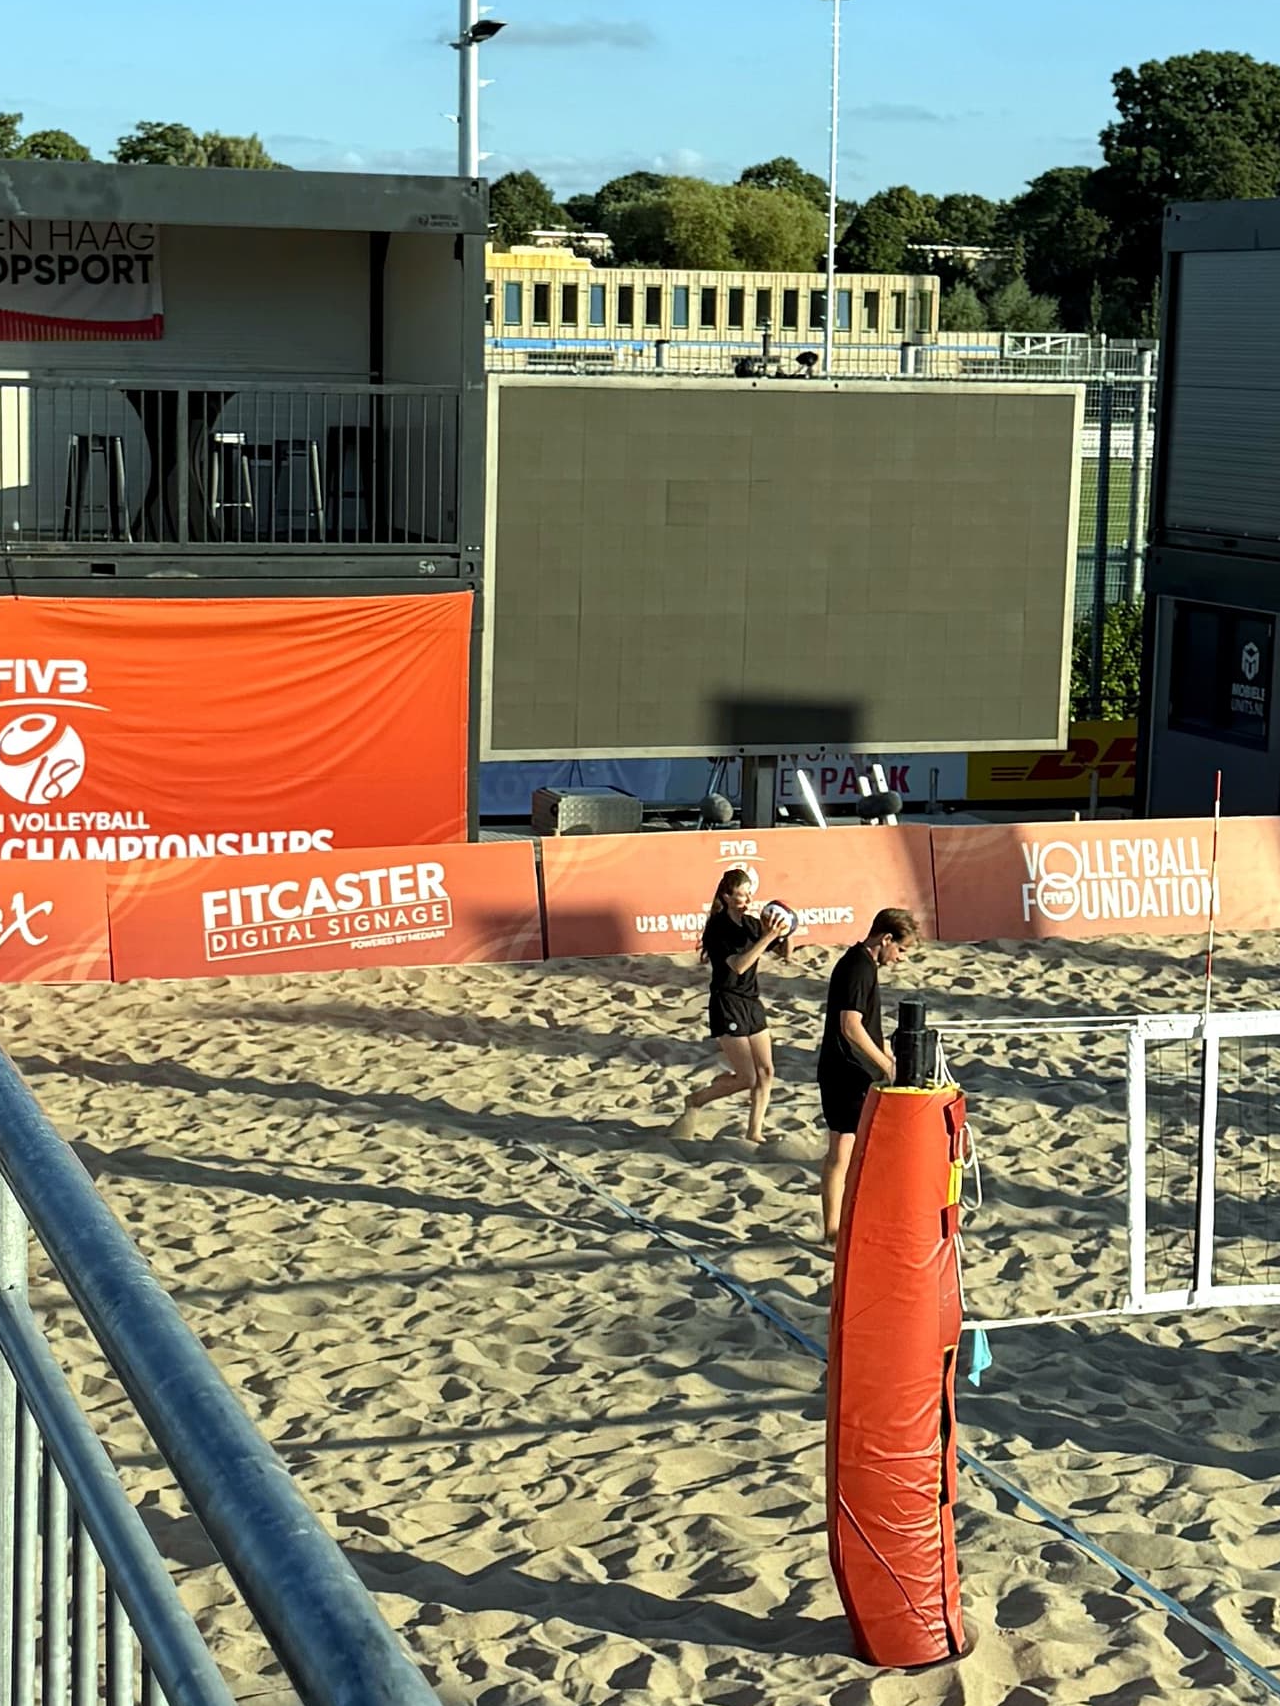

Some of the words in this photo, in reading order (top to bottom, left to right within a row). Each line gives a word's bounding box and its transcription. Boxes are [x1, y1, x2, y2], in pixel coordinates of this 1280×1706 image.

[49, 219, 155, 251] HAAG
[9, 810, 150, 832] VOLLEYBALL
[719, 840, 757, 856] FIVB
[1021, 837, 1209, 889] VOLLEYBALL
[201, 862, 449, 930] FITCASTER
[1021, 873, 1221, 922] FOUNDATION
[1042, 891, 1074, 905] FIVB
[212, 922, 316, 953] DIGITAL
[327, 904, 445, 936] SIGNAGE
[635, 915, 668, 933] U18
